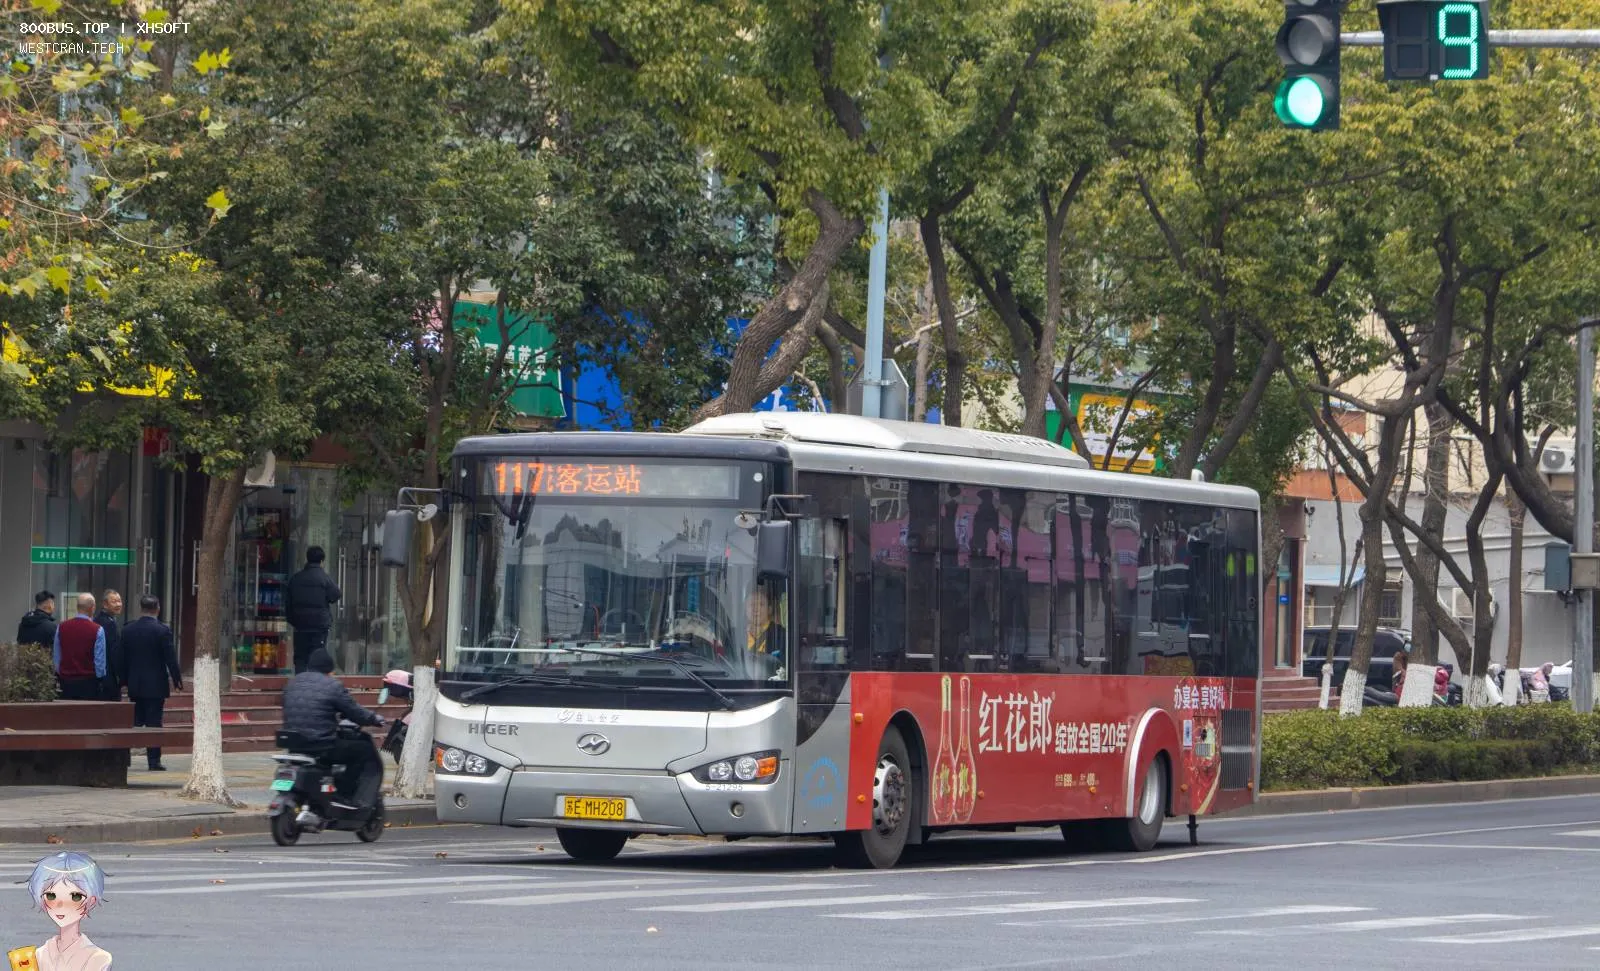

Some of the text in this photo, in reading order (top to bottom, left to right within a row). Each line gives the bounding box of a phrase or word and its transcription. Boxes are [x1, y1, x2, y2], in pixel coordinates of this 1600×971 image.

[1438, 4, 1478, 79] 9
[495, 462, 545, 495] 117
[468, 722, 519, 736] HIGER
[979, 690, 1053, 755] 红花郎
[1055, 721, 1127, 754] 绽放全国20年
